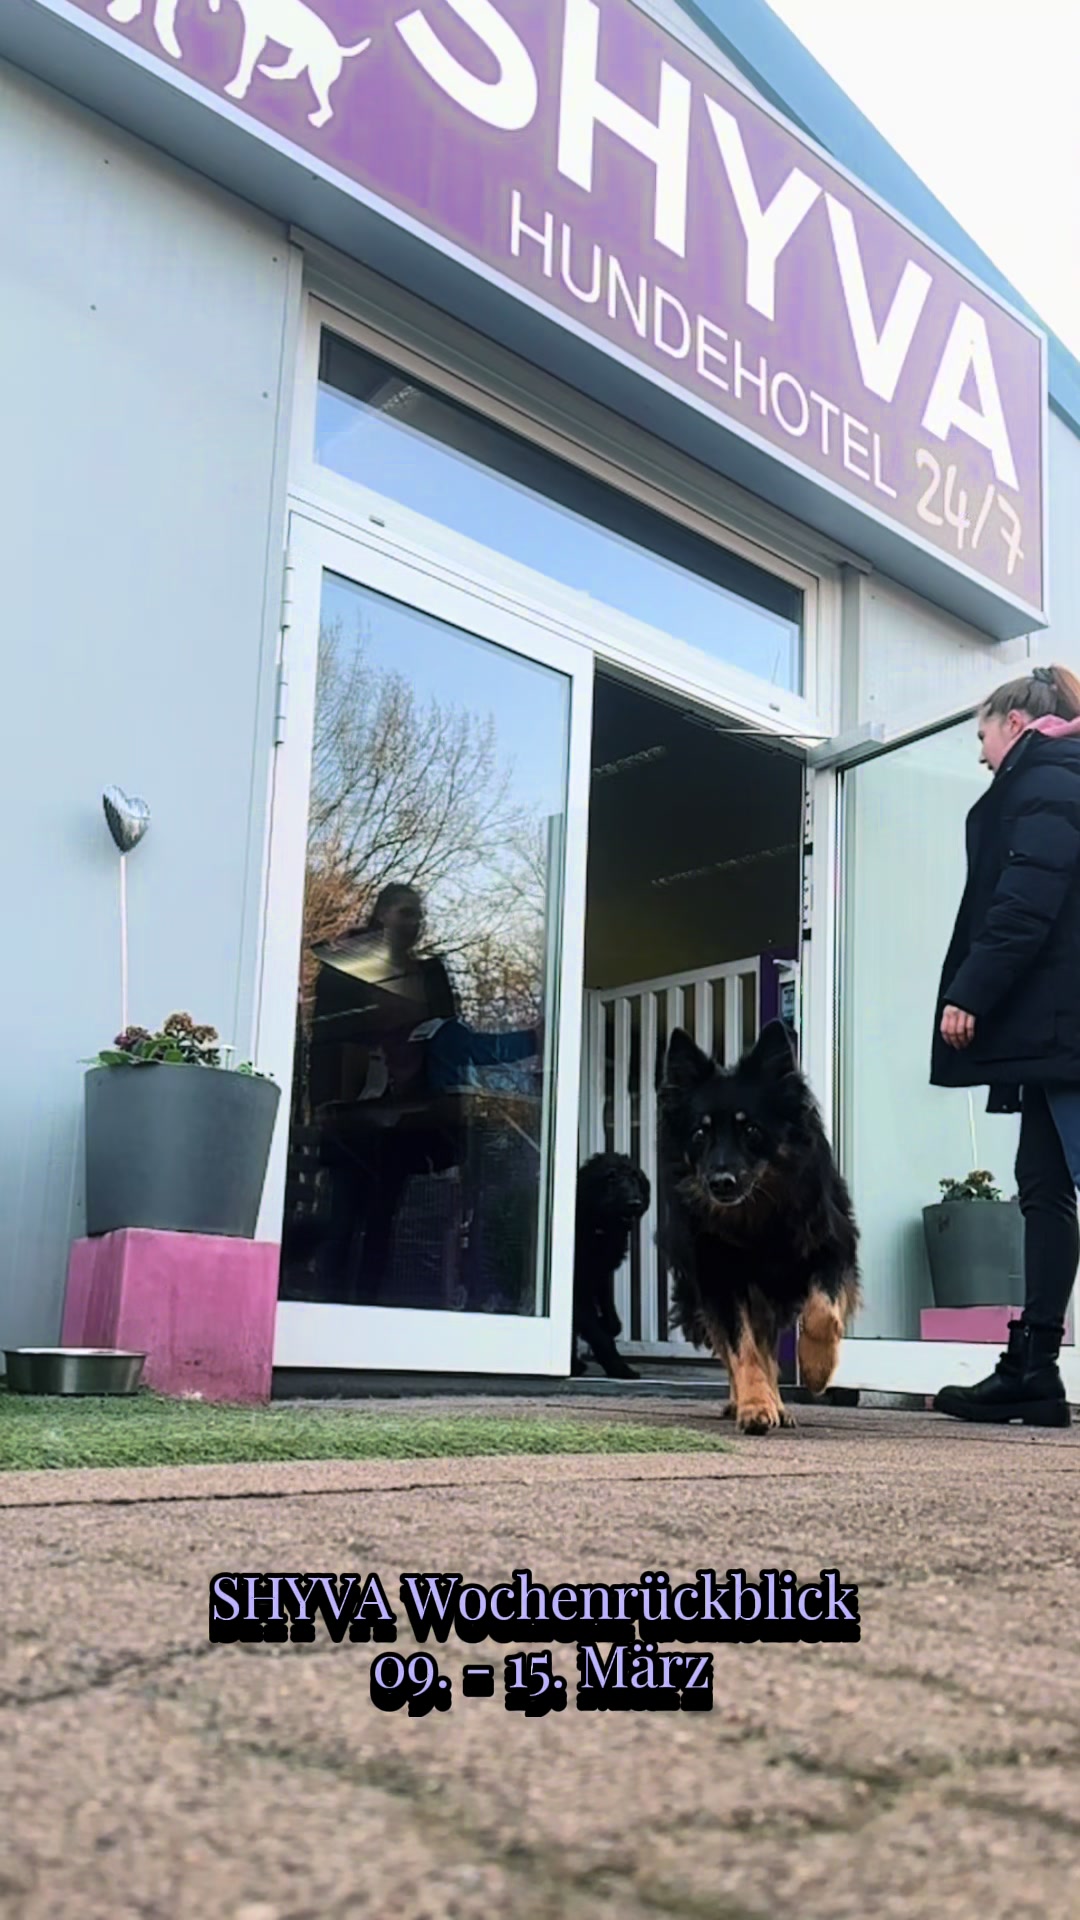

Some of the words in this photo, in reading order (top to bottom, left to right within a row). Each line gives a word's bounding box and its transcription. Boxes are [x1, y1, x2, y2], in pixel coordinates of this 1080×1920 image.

[395, 0, 1020, 493] SHYVA
[510, 190, 898, 499] HUNDEHOTEL
[915, 448, 1025, 576] 24/7
